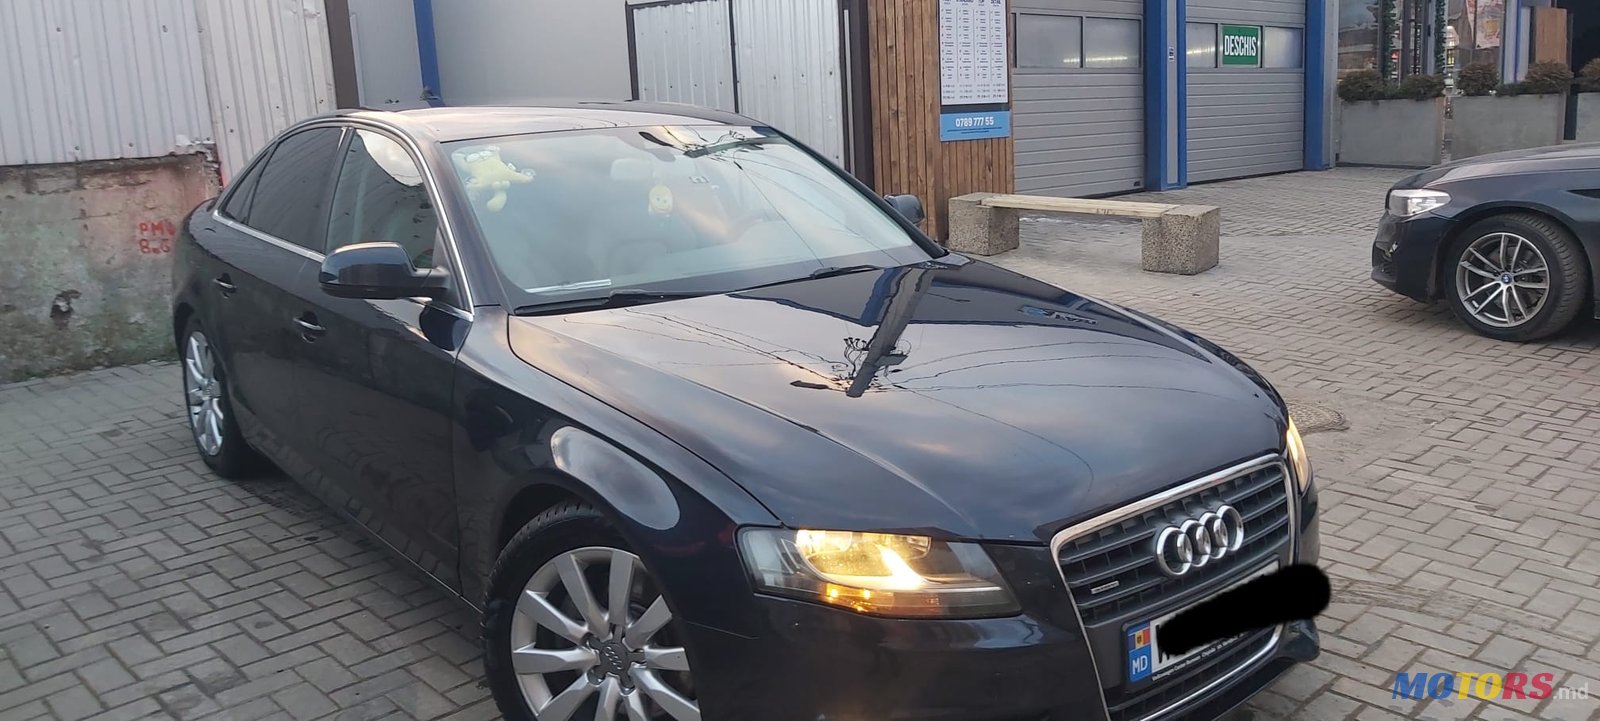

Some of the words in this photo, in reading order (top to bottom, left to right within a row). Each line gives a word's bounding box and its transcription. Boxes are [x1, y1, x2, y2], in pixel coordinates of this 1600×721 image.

[1224, 35, 1257, 57] DESCHIS
[955, 117, 973, 127] 0789
[973, 117, 984, 127] 777
[985, 116, 994, 126] 55
[1132, 655, 1148, 674] MD
